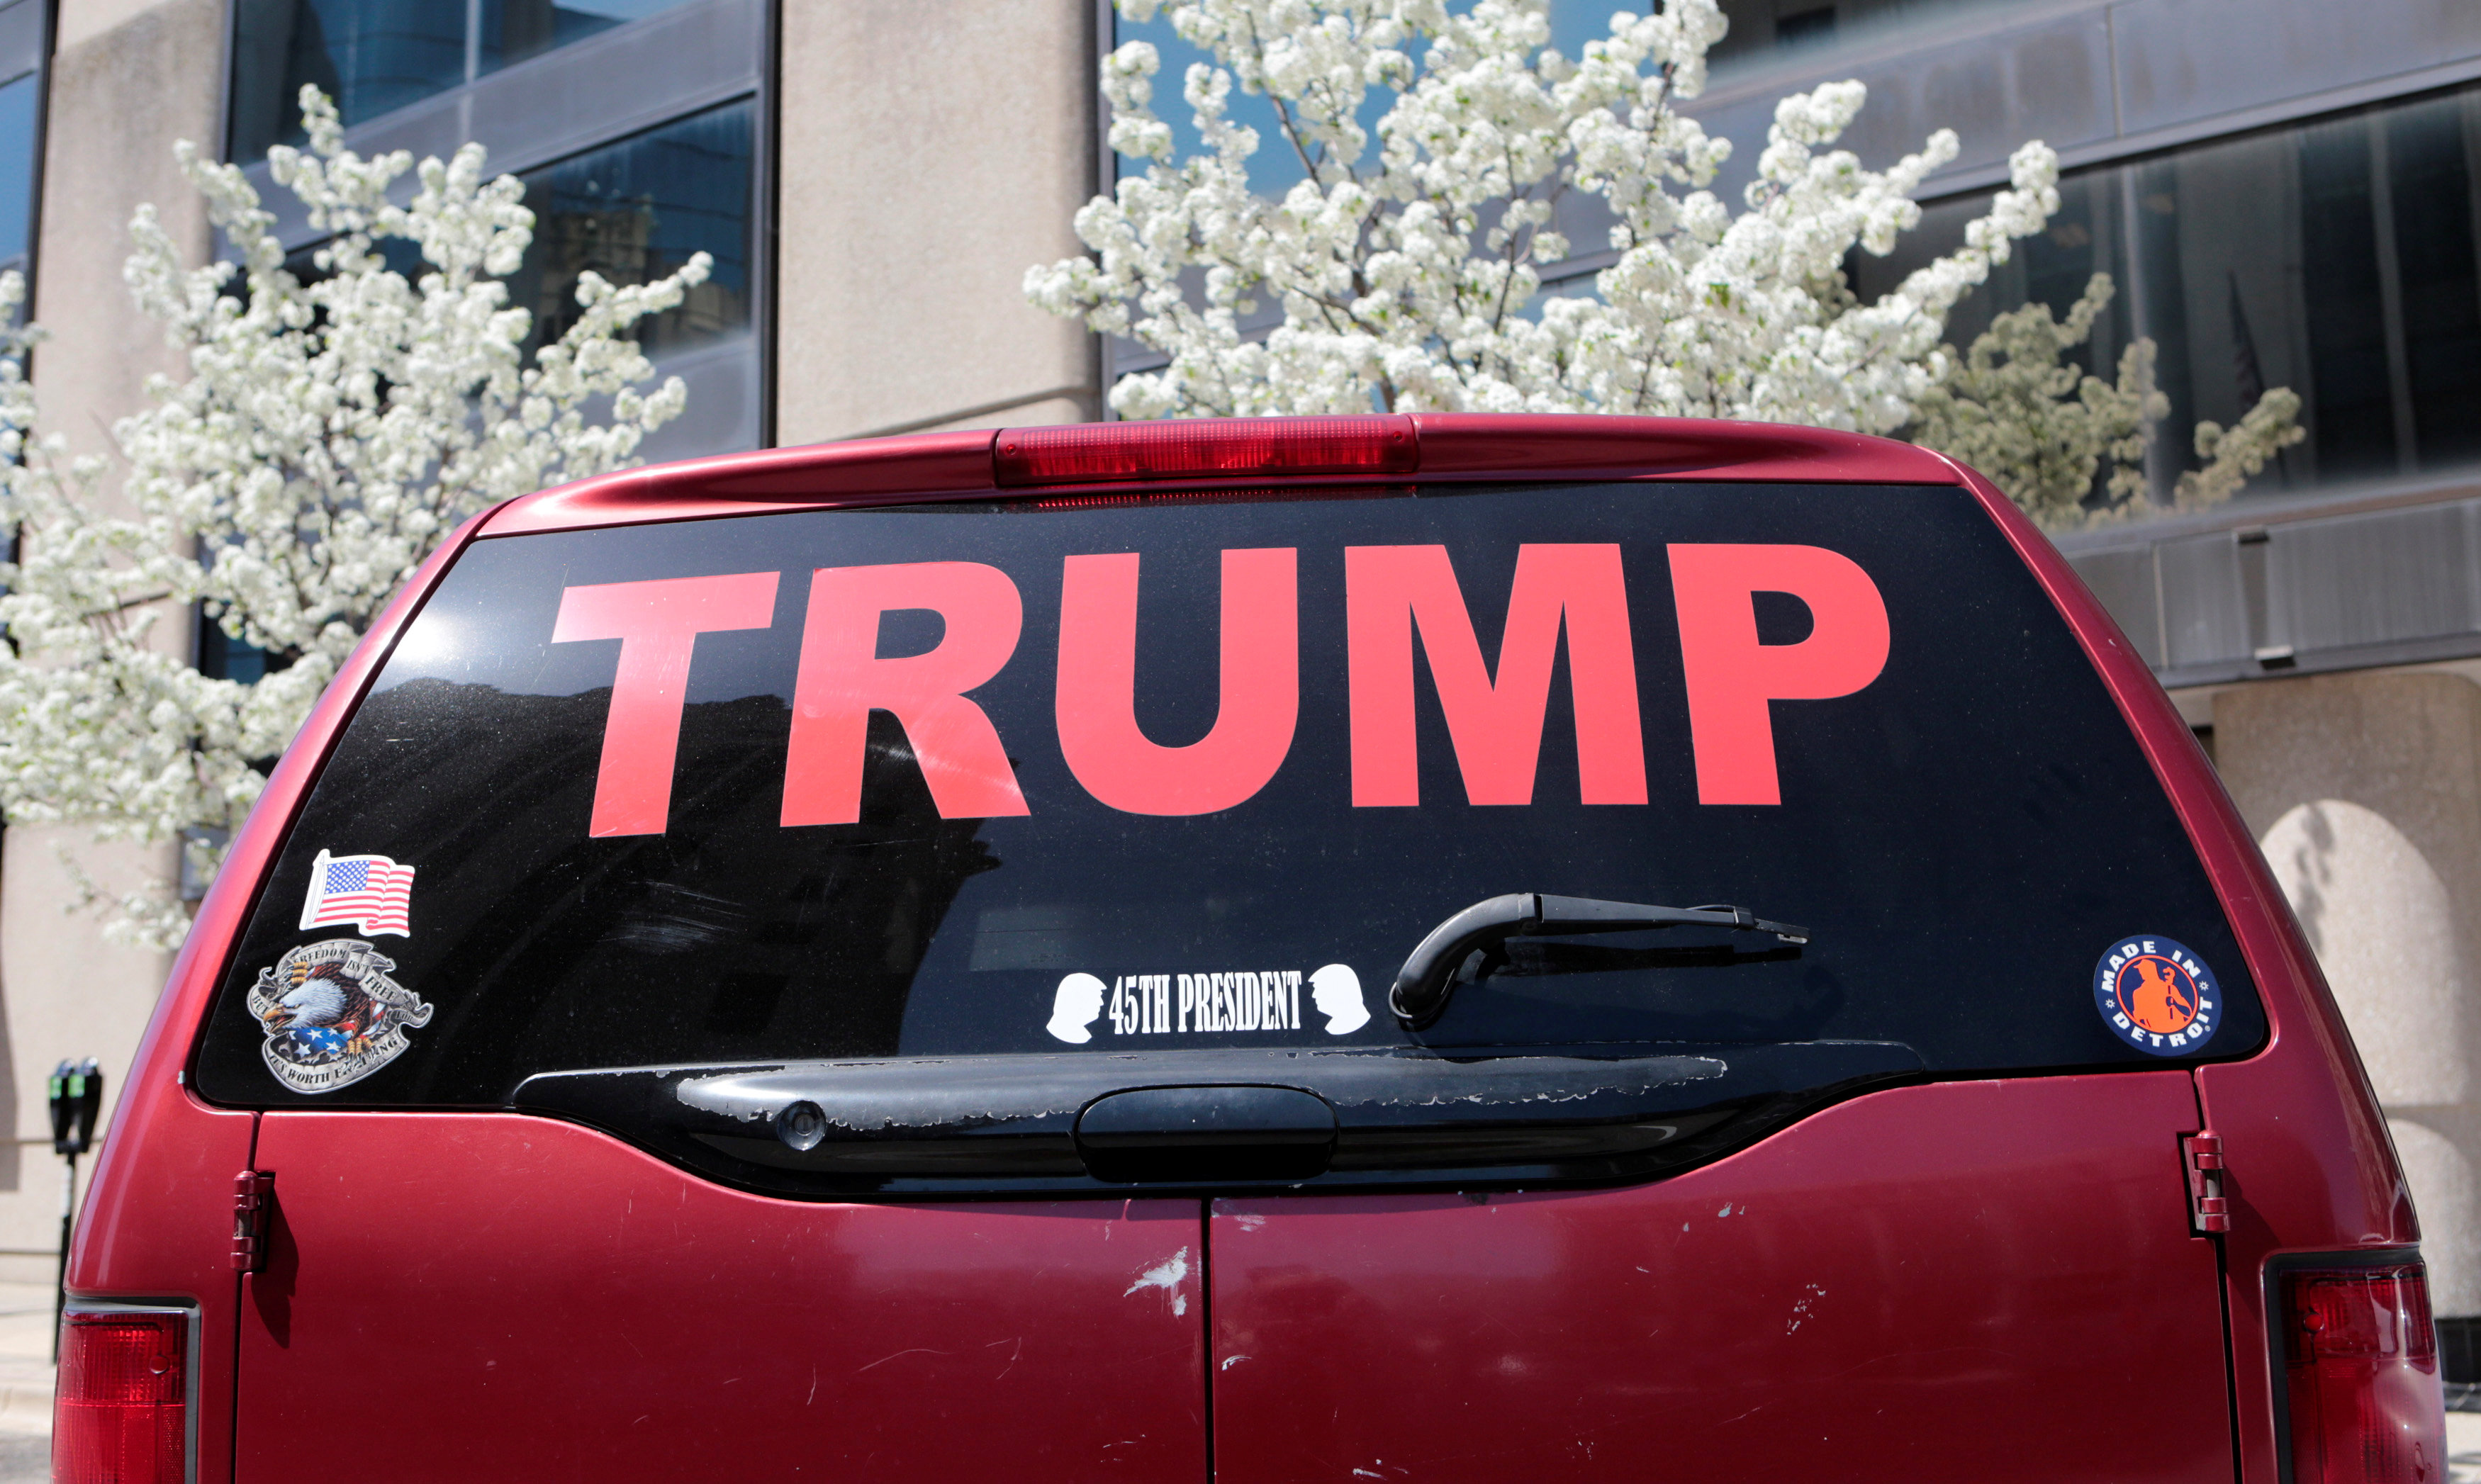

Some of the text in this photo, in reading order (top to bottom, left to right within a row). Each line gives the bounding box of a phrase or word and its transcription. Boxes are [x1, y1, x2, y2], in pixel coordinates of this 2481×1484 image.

[551, 543, 1891, 838] TRUMP
[364, 976, 396, 1000] FREE
[2101, 940, 2202, 992] MADE IN
[252, 995, 268, 1014] BUT
[396, 1011, 413, 1022] FOR
[1108, 971, 1302, 1035] 45TH PRESIDENT
[2112, 996, 2212, 1047] DETROIT
[269, 1037, 398, 1084] IT'S WORTH FING
